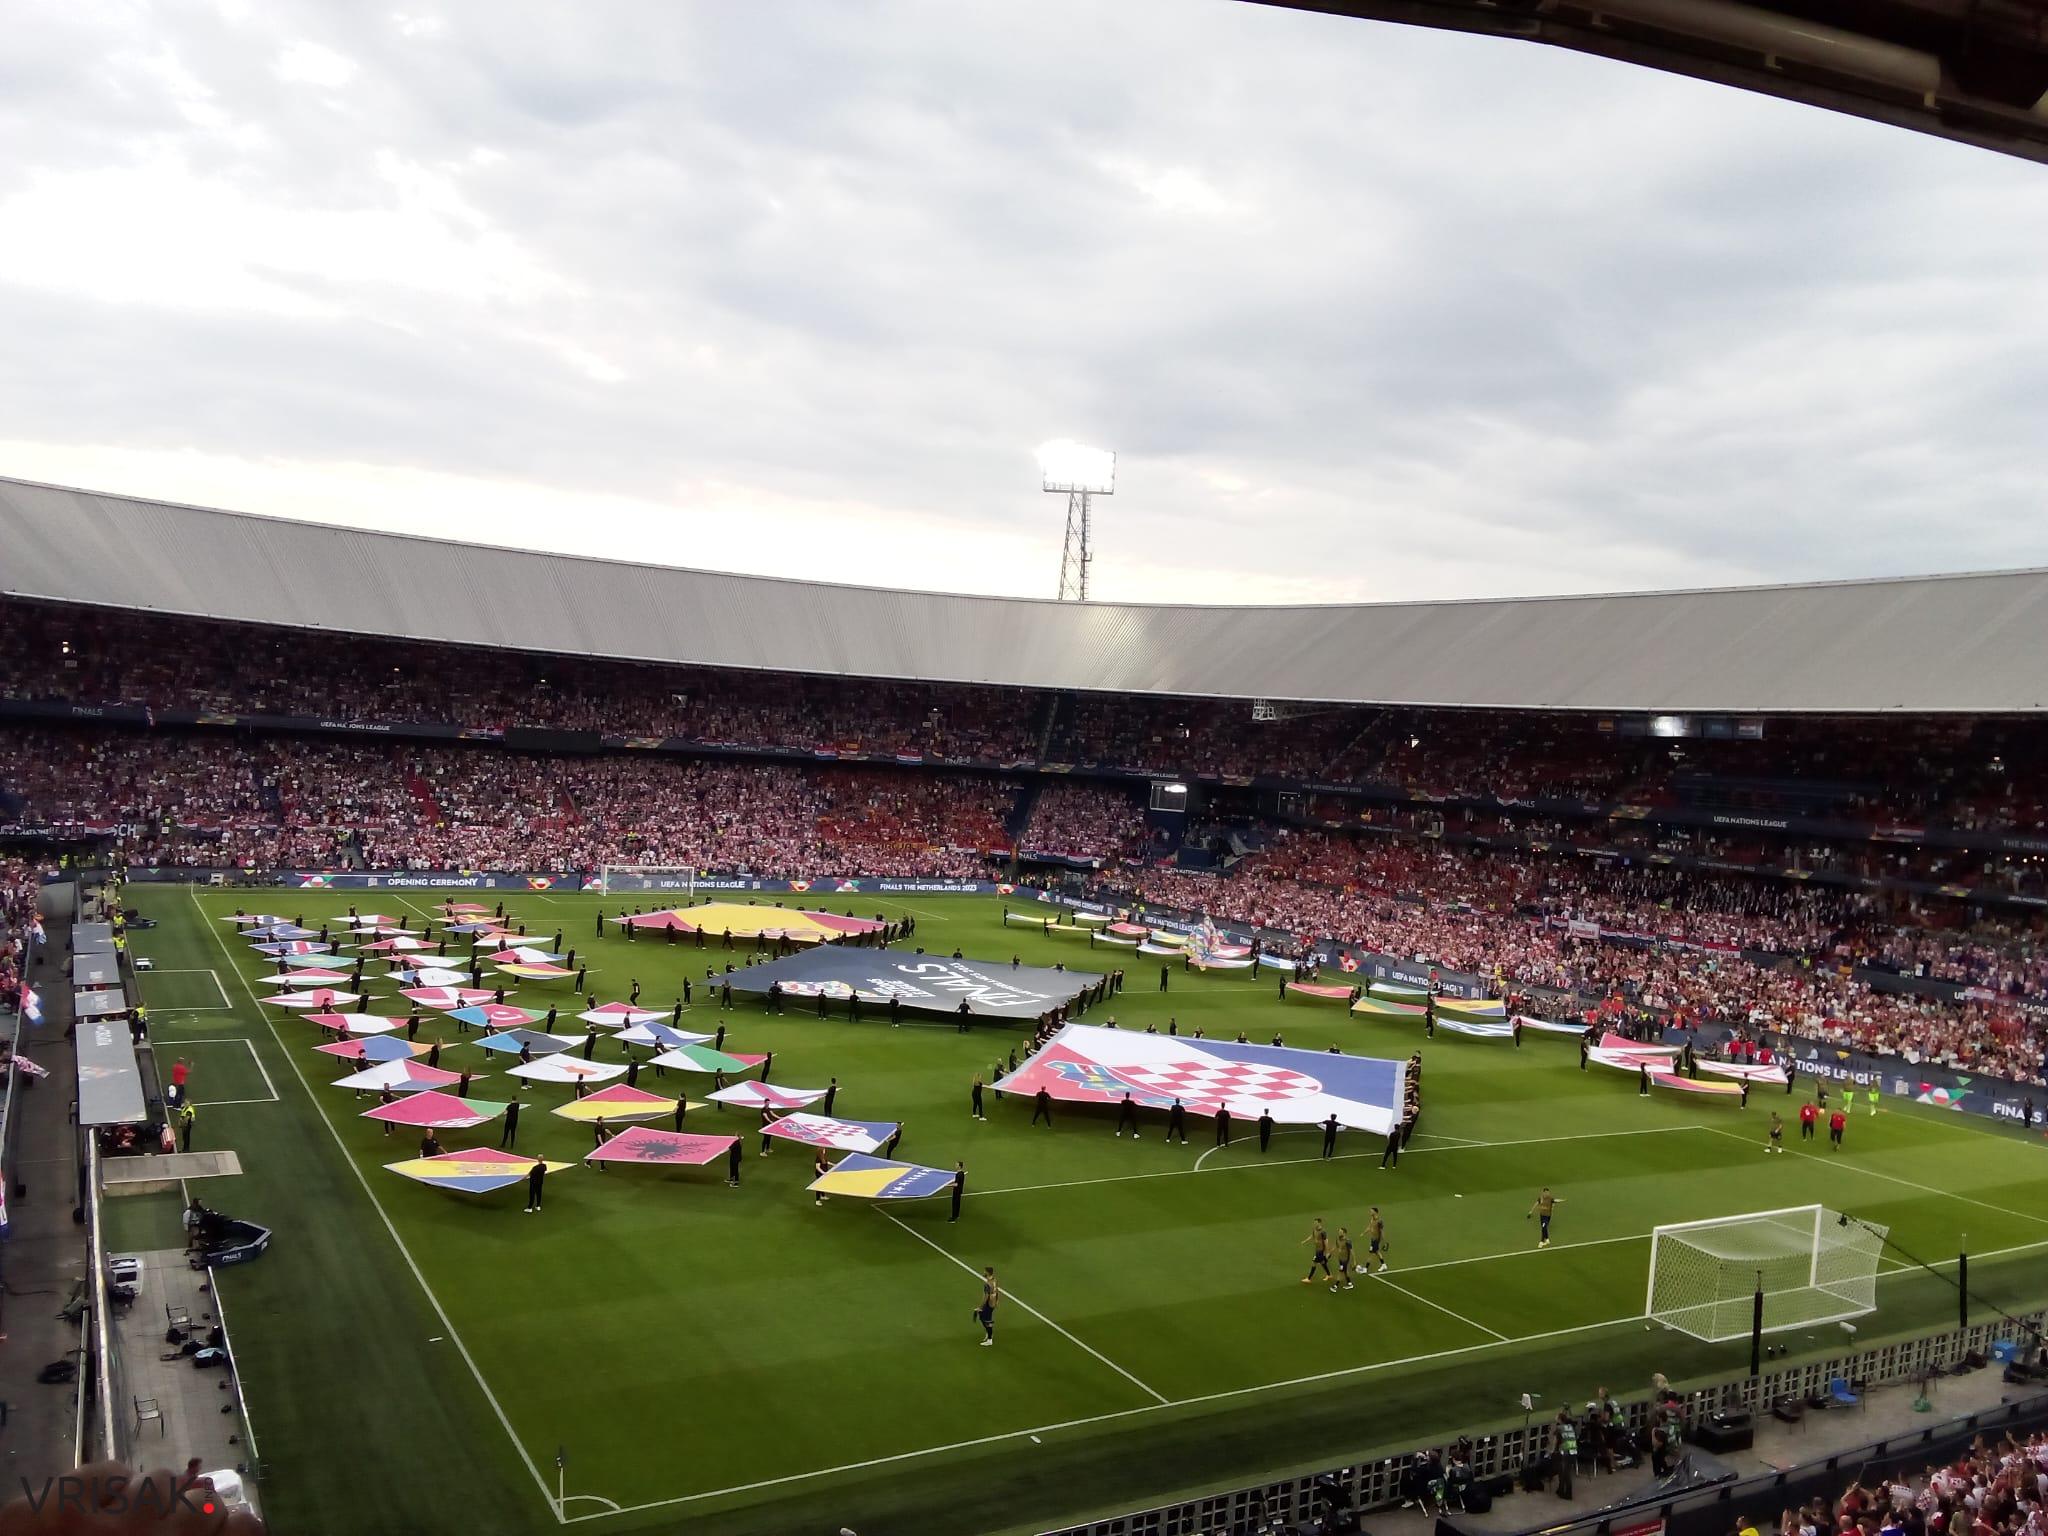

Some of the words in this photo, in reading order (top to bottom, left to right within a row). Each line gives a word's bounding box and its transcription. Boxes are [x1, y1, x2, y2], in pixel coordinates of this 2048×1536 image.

[1517, 800, 1535, 808] NALS
[388, 878, 428, 886] OPENING
[430, 878, 478, 887] CEREMONY
[660, 880, 680, 888] UEFA
[961, 883, 977, 891] 2023
[1392, 971, 1408, 981] UEFA
[1408, 975, 1429, 985] NATIO
[897, 963, 1041, 1007] FINALS
[1779, 1055, 1831, 1077] NTIONS
